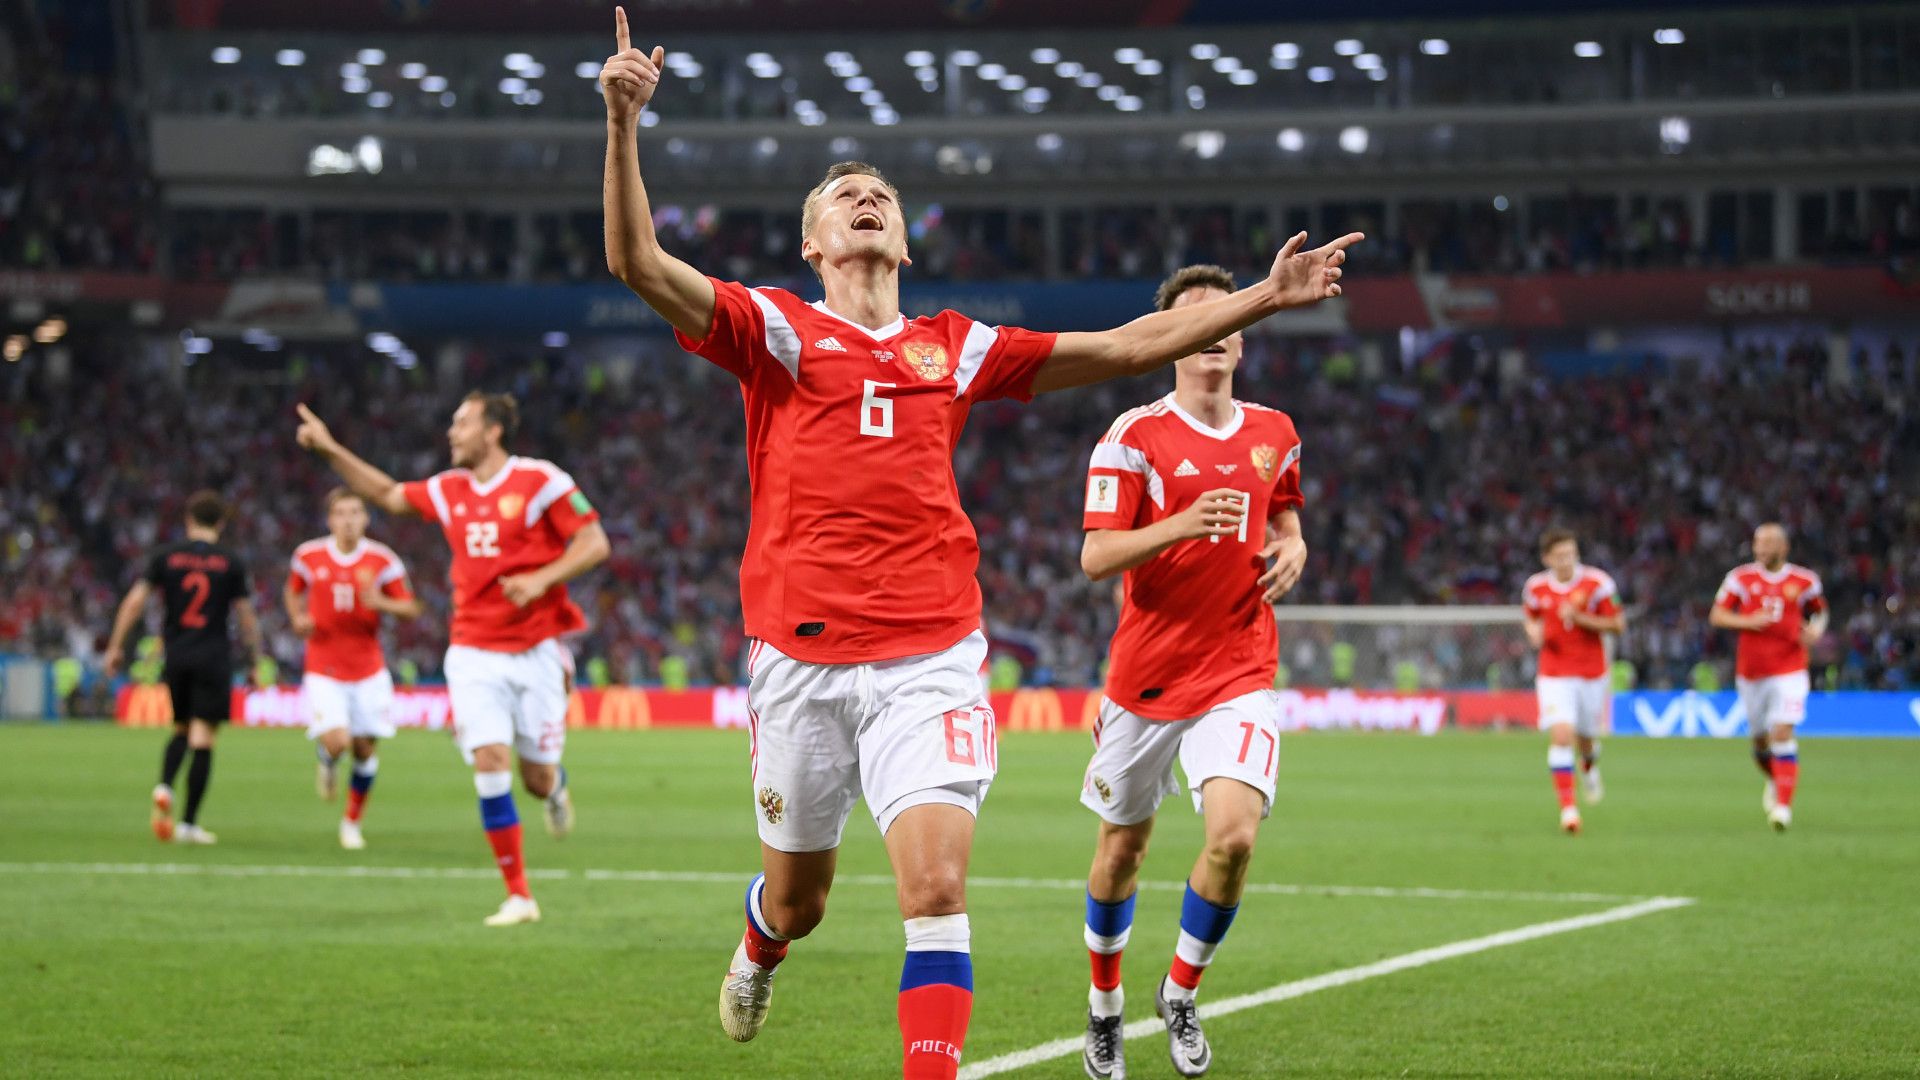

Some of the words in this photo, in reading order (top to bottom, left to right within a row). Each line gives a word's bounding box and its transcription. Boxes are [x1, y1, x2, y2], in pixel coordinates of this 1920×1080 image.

[1707, 283, 1811, 311] SOCHI
[860, 379, 897, 437] 6
[465, 521, 501, 558] 22
[180, 571, 211, 629] 2
[943, 709, 976, 766] 6
[1236, 721, 1275, 778] 17
